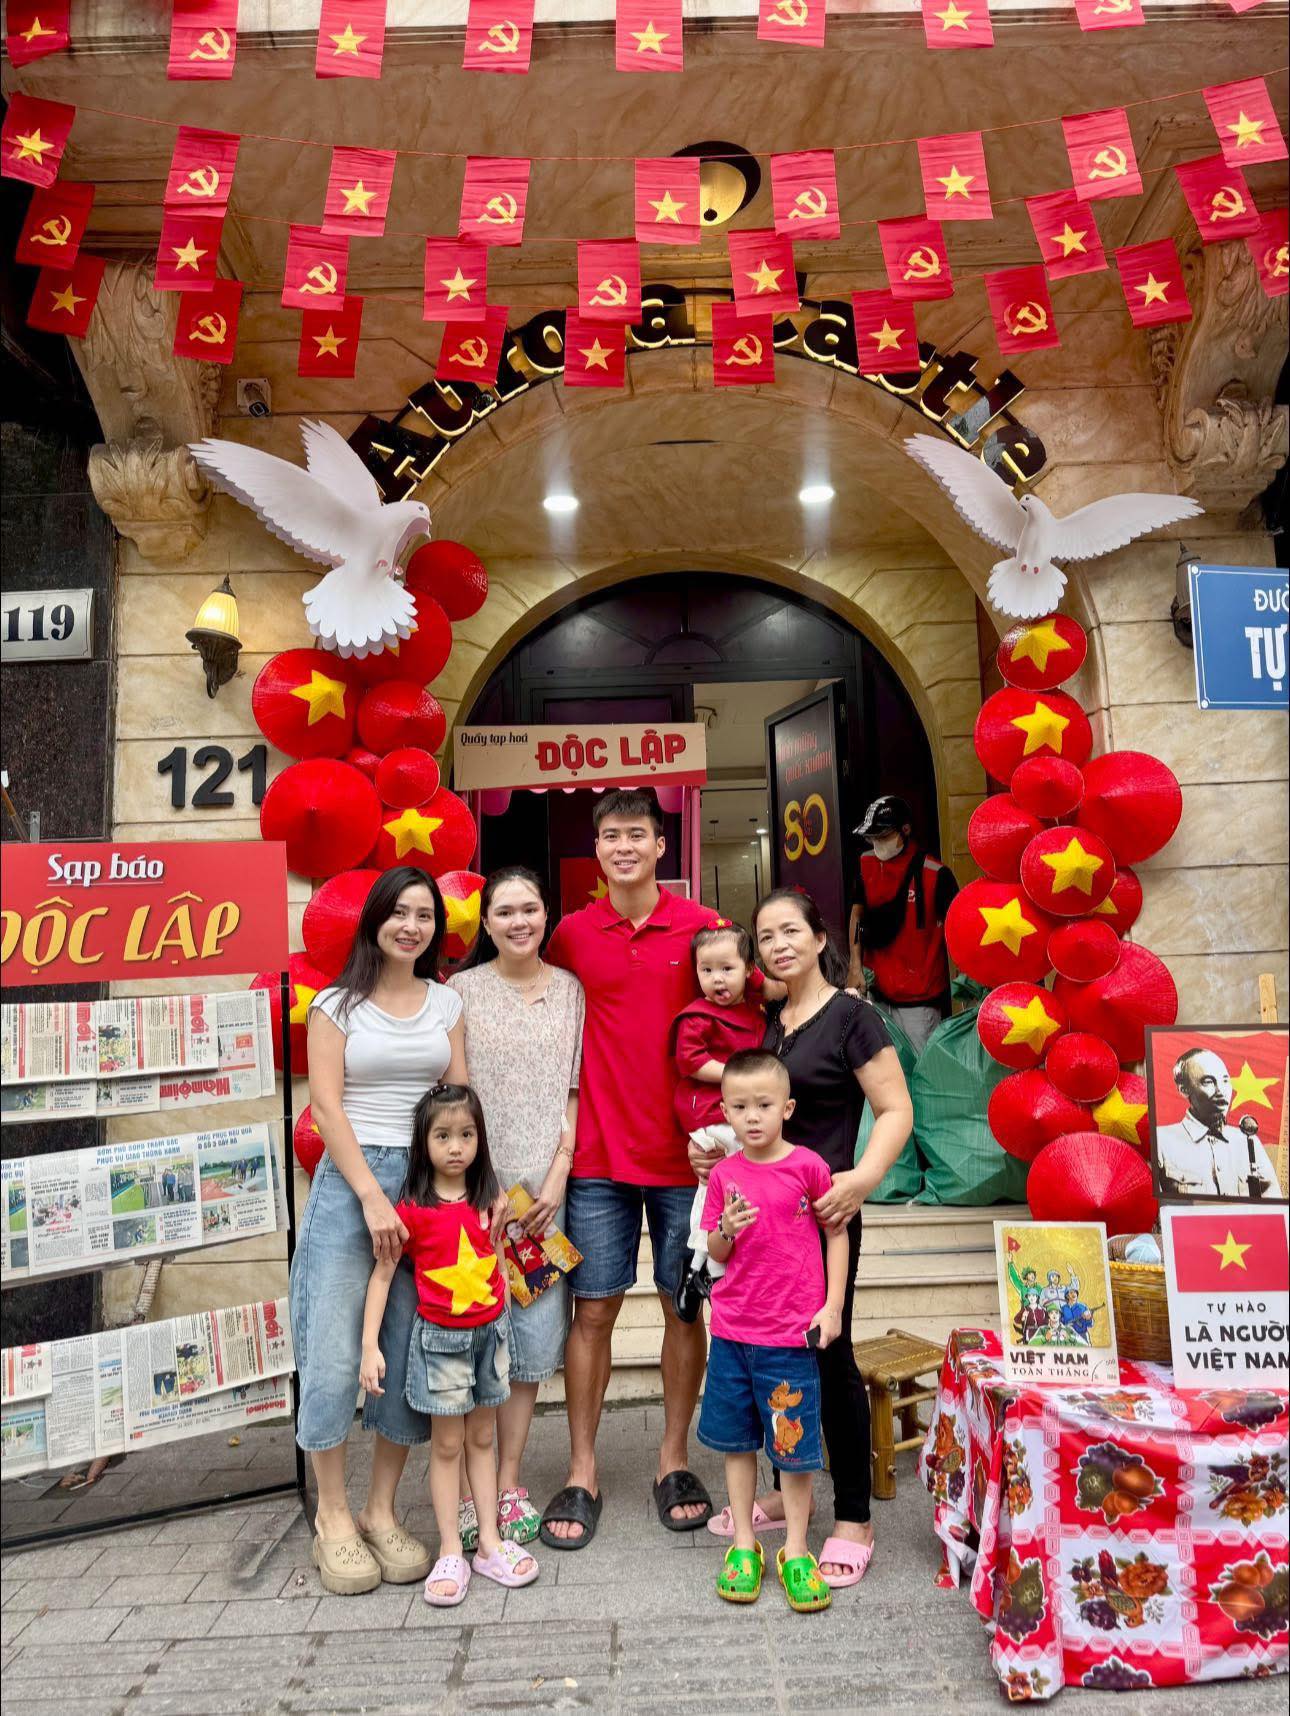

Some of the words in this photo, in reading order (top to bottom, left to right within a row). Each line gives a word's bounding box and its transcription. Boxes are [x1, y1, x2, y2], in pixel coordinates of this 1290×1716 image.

[347, 284, 695, 501] Auroa
[3, 604, 75, 642] 119
[1245, 624, 1288, 691] TỰ
[535, 733, 608, 776] ĐỘC
[619, 729, 687, 771] LẬP
[157, 744, 267, 809] 121
[784, 793, 829, 861] 80
[48, 853, 102, 887] Sạp
[109, 853, 164, 879] báo
[123, 891, 241, 964] LẬP
[1207, 1302, 1226, 1315] TỰ
[1236, 1300, 1266, 1313] HÀO
[1185, 1320, 1213, 1342] LÀ
[1010, 1350, 1046, 1365] VIỆT
[1053, 1352, 1089, 1365] NAM
[1012, 1366, 1043, 1376] TOÀN
[1186, 1347, 1237, 1371] VIỆT
[1244, 1351, 1289, 1369] NAM
